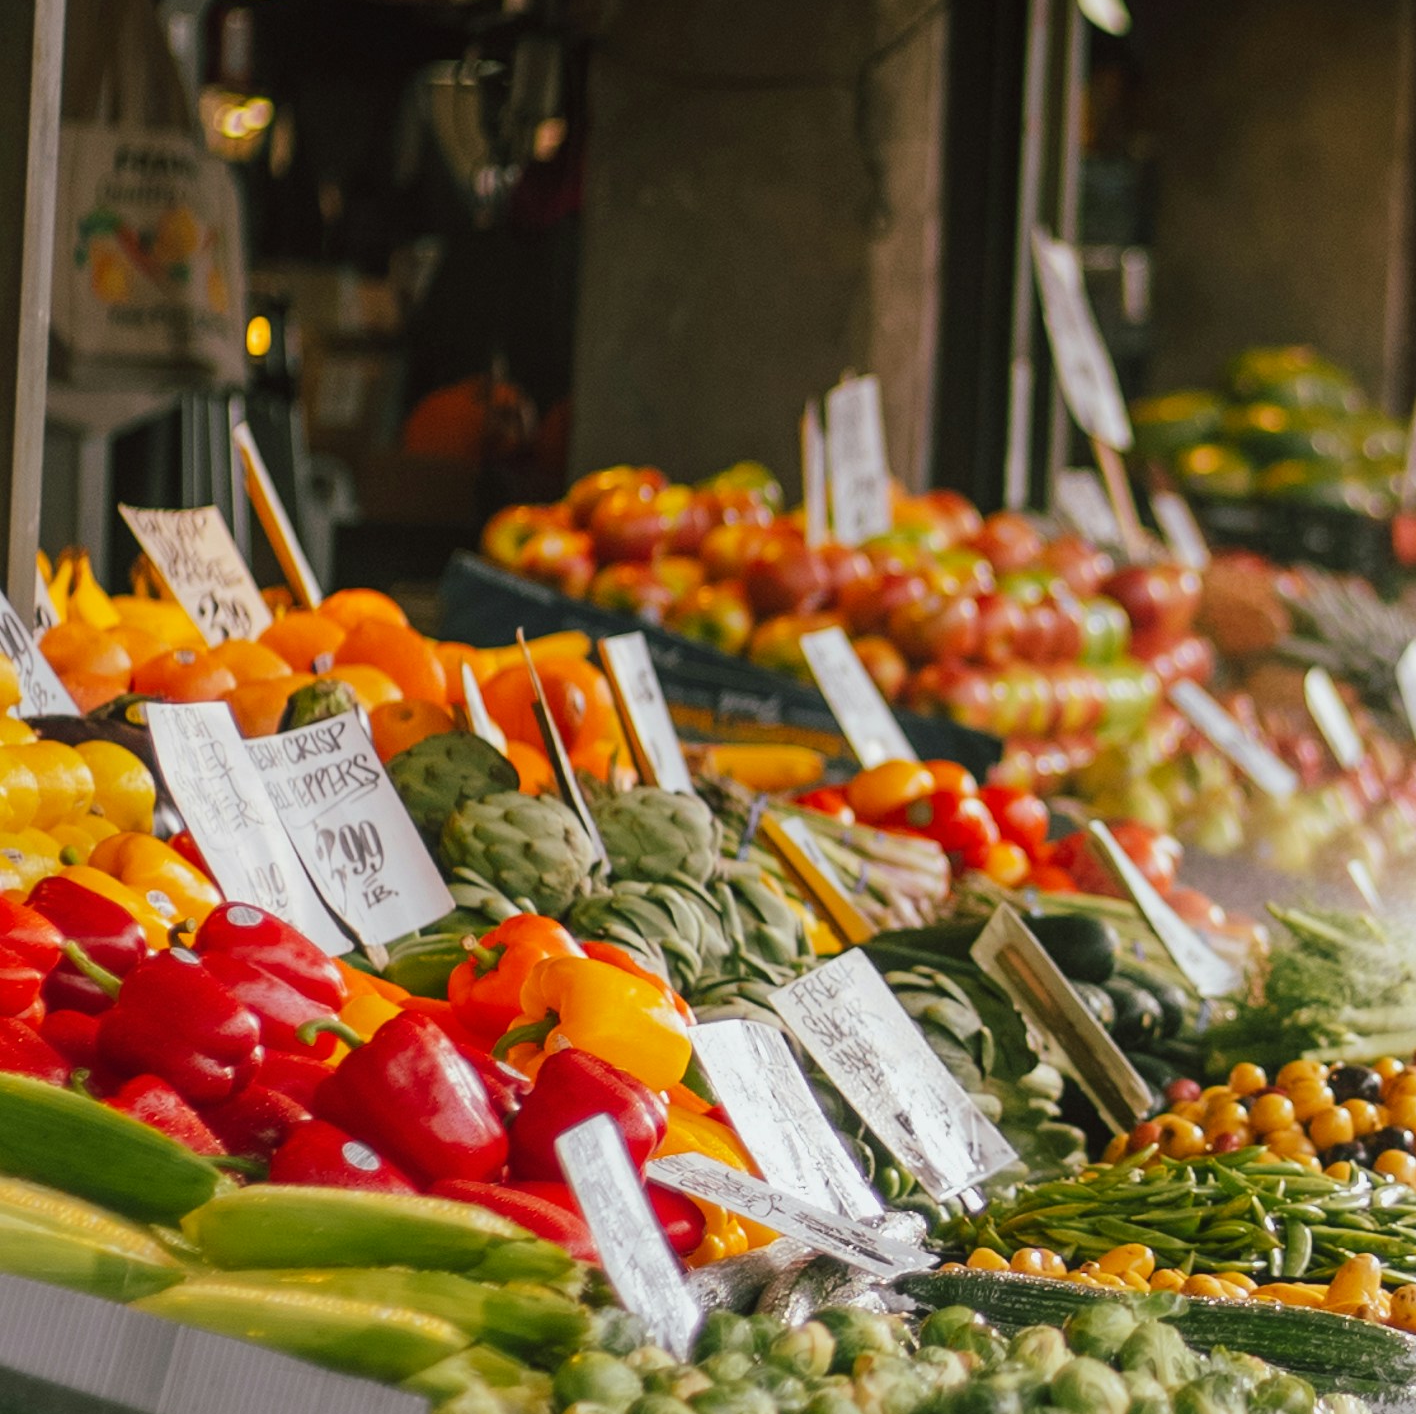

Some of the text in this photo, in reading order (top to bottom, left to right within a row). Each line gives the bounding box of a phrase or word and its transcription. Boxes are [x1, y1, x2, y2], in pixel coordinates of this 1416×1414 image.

[282, 721, 346, 765] CRISP
[286, 753, 381, 809] PEPPERS
[788, 960, 857, 1016] FRESH
